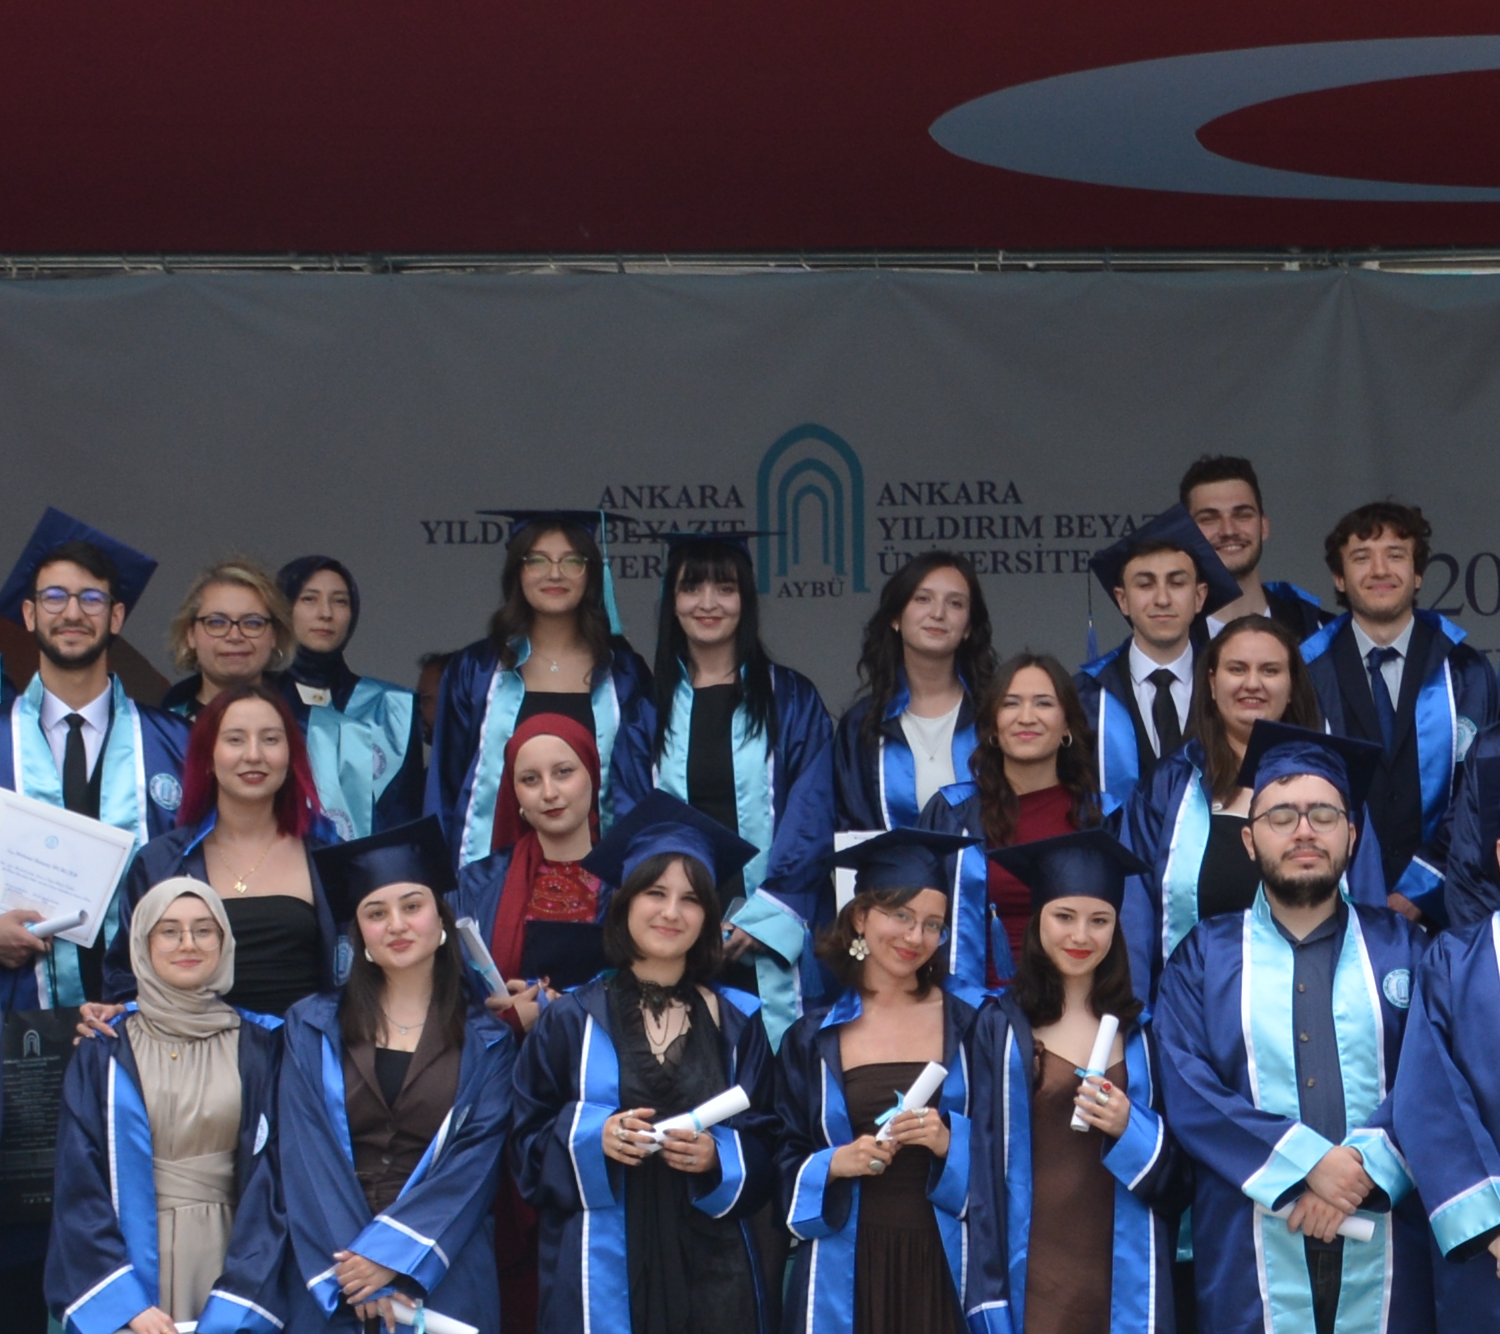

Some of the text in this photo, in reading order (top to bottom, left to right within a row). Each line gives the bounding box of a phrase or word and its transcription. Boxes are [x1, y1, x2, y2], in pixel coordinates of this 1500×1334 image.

[597, 484, 746, 510] ANKARA
[876, 480, 1023, 506] ANKARA
[876, 514, 1044, 541] YILDIRIM
[776, 575, 846, 598] AYBÜ
